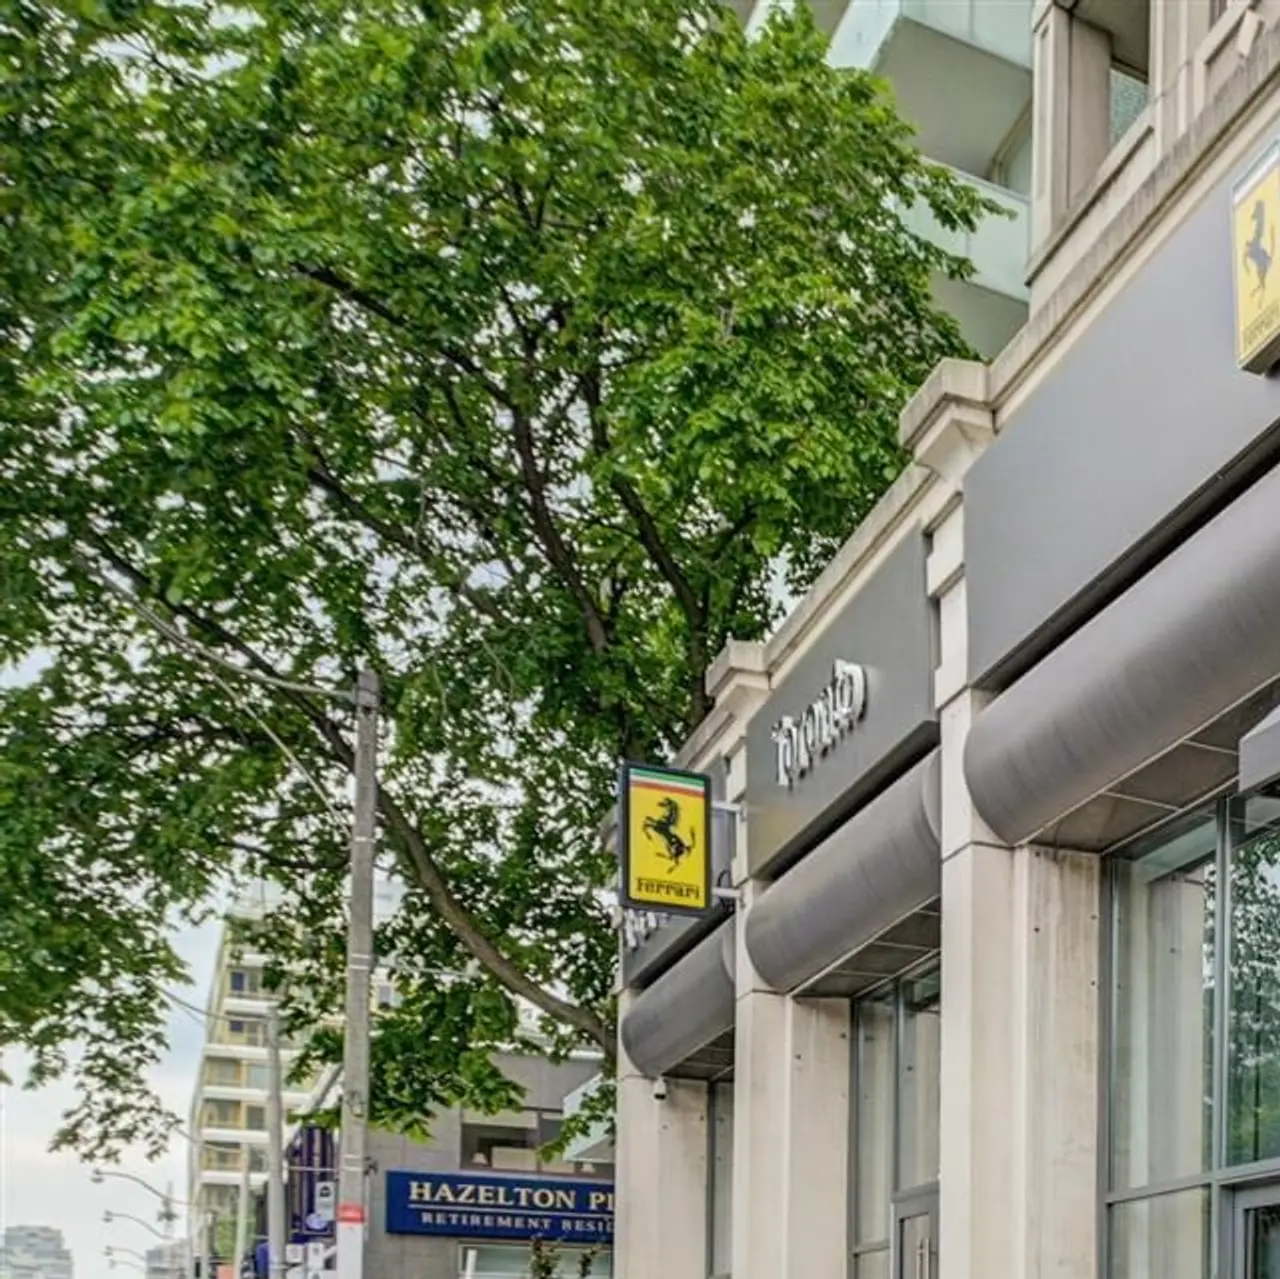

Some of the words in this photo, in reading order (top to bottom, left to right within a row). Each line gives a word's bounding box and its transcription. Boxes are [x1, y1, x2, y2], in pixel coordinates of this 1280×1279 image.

[636, 876, 701, 900] Ferrari
[408, 1180, 577, 1210] HAZELTON
[420, 1211, 553, 1231] RETIREMENT
